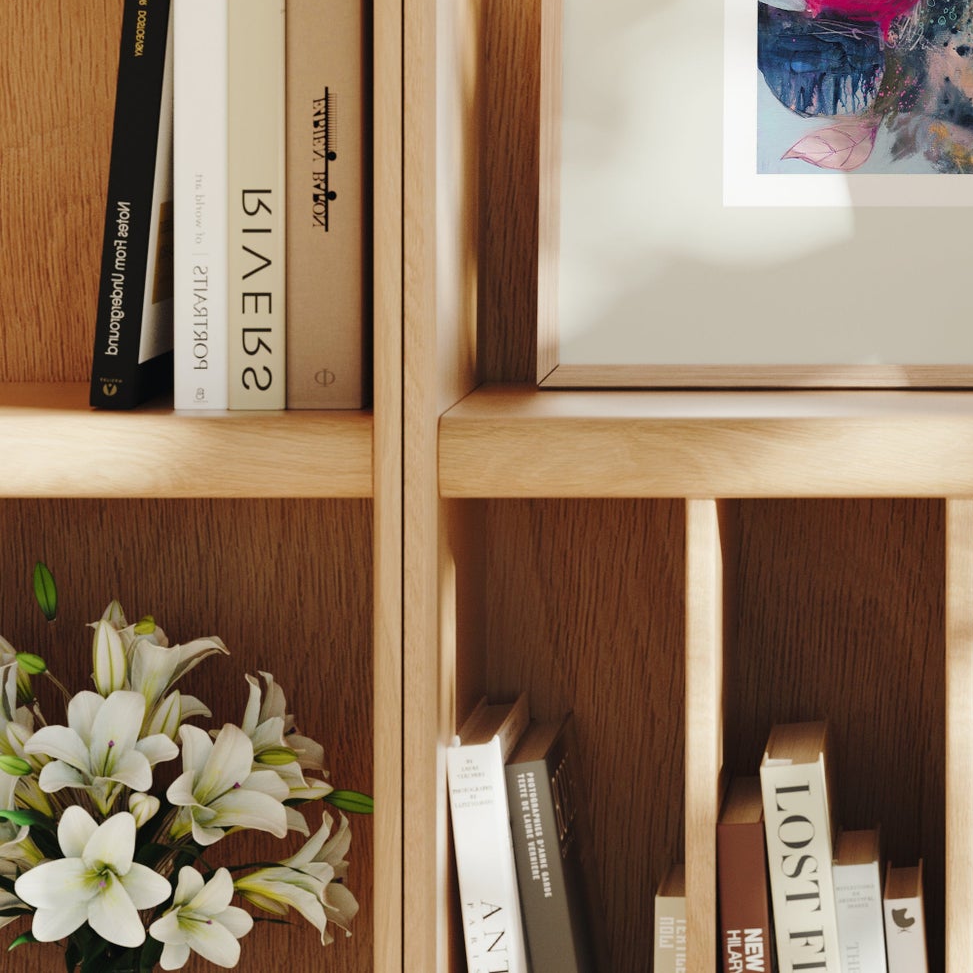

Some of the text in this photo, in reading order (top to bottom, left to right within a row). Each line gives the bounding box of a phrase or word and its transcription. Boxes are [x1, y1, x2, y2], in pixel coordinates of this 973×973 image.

[517, 773, 528, 798] TEXTE
[521, 800, 530, 812] DE
[774, 780, 822, 913] LOST
[466, 902, 481, 973] PARI
[726, 929, 744, 973] HILAR
[743, 928, 765, 972] NEW
